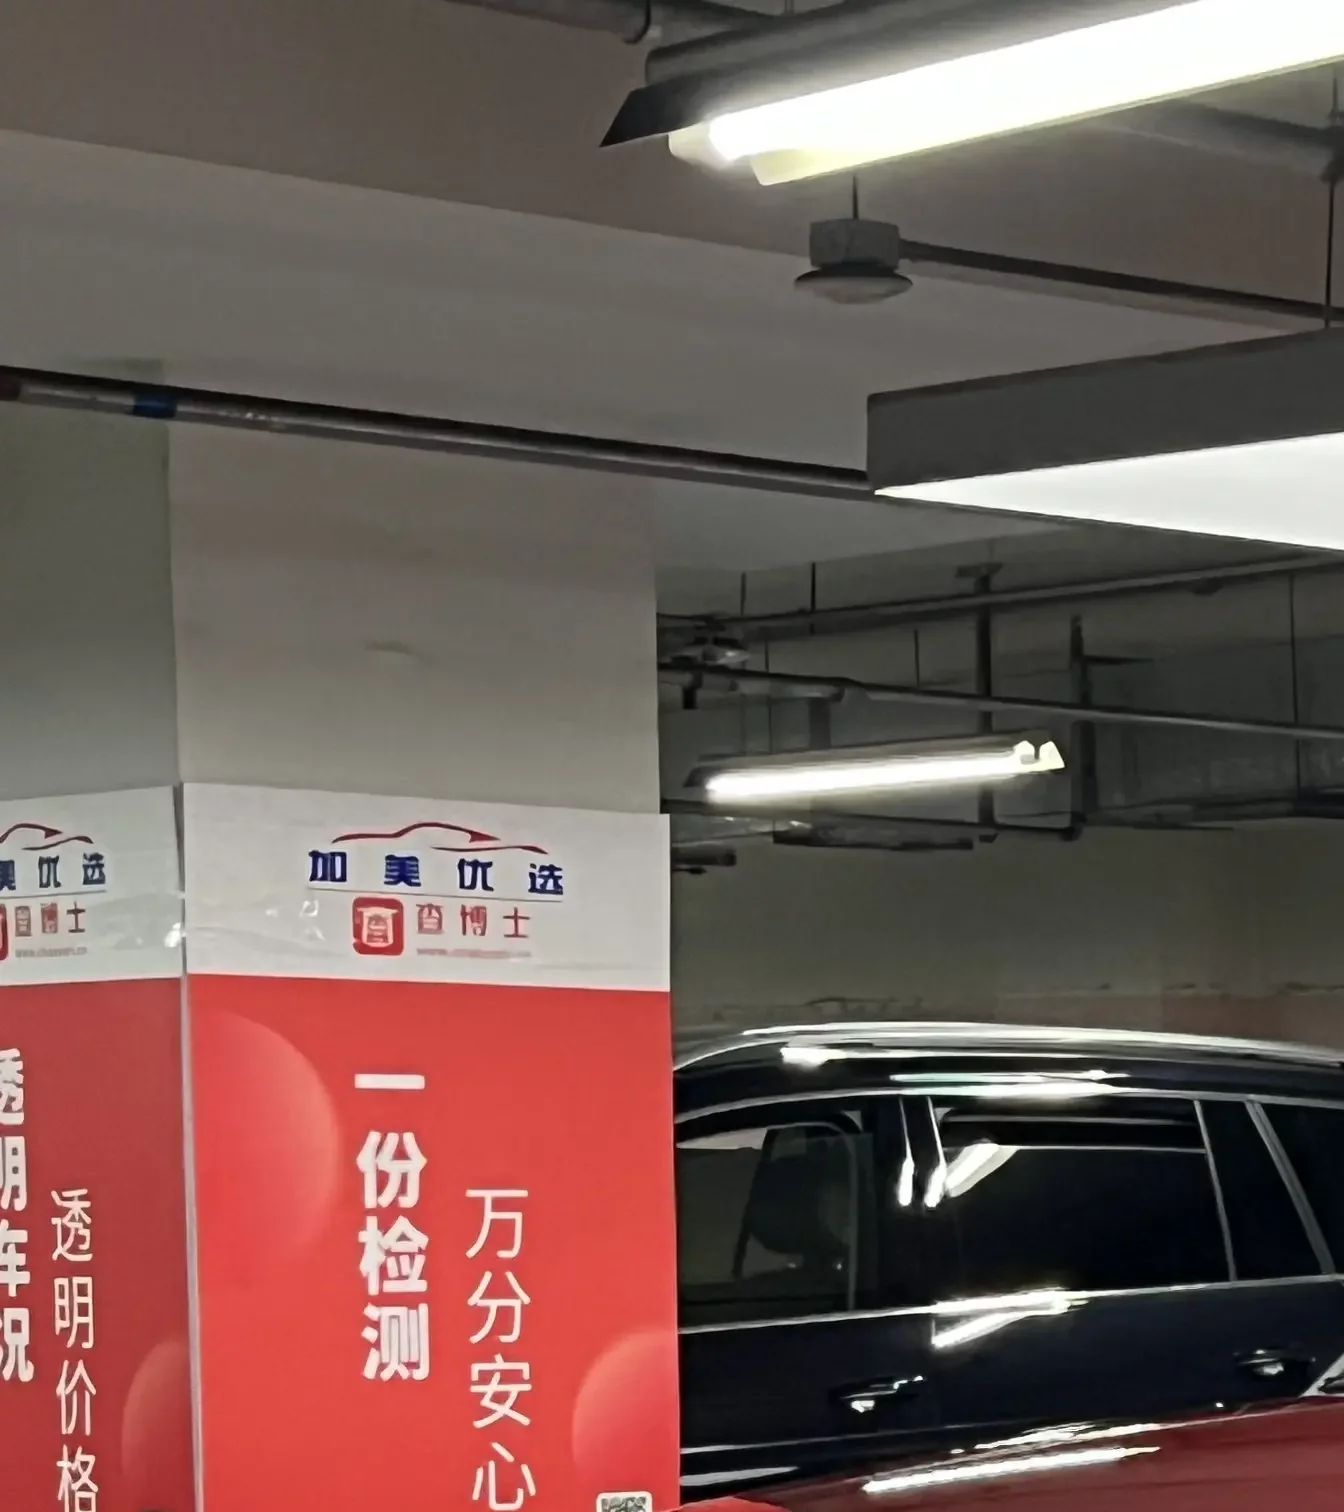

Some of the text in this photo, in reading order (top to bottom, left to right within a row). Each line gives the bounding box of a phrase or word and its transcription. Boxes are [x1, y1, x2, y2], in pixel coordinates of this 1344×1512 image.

[308, 850, 564, 895] 加美优选
[353, 1073, 430, 1382] 一份检测
[464, 1188, 537, 1512] 万分安心
